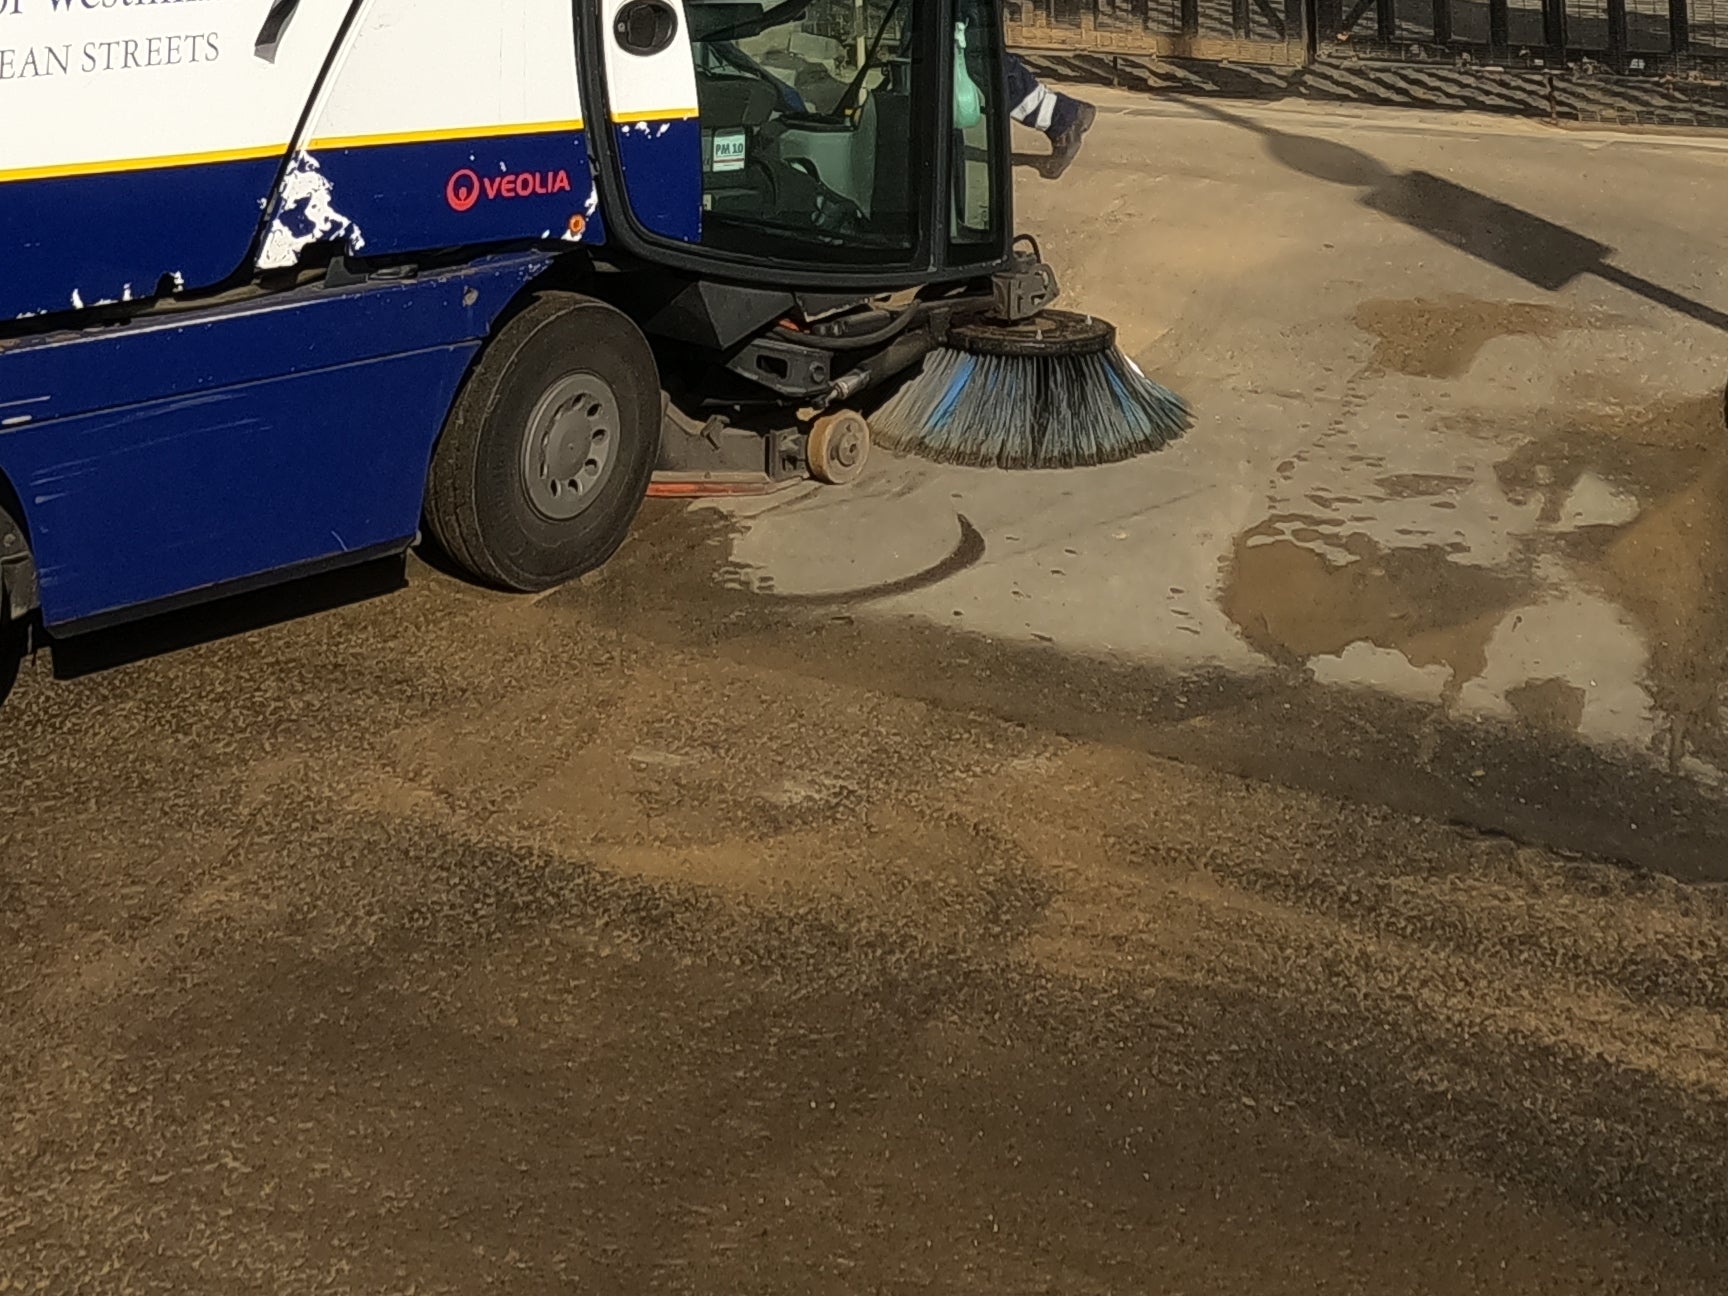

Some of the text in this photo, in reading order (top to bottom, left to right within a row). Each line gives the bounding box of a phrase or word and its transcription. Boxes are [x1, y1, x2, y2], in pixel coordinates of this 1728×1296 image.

[81, 31, 220, 73] STREETS
[715, 142, 744, 155] PM 10
[483, 169, 571, 200] VEOLIA
